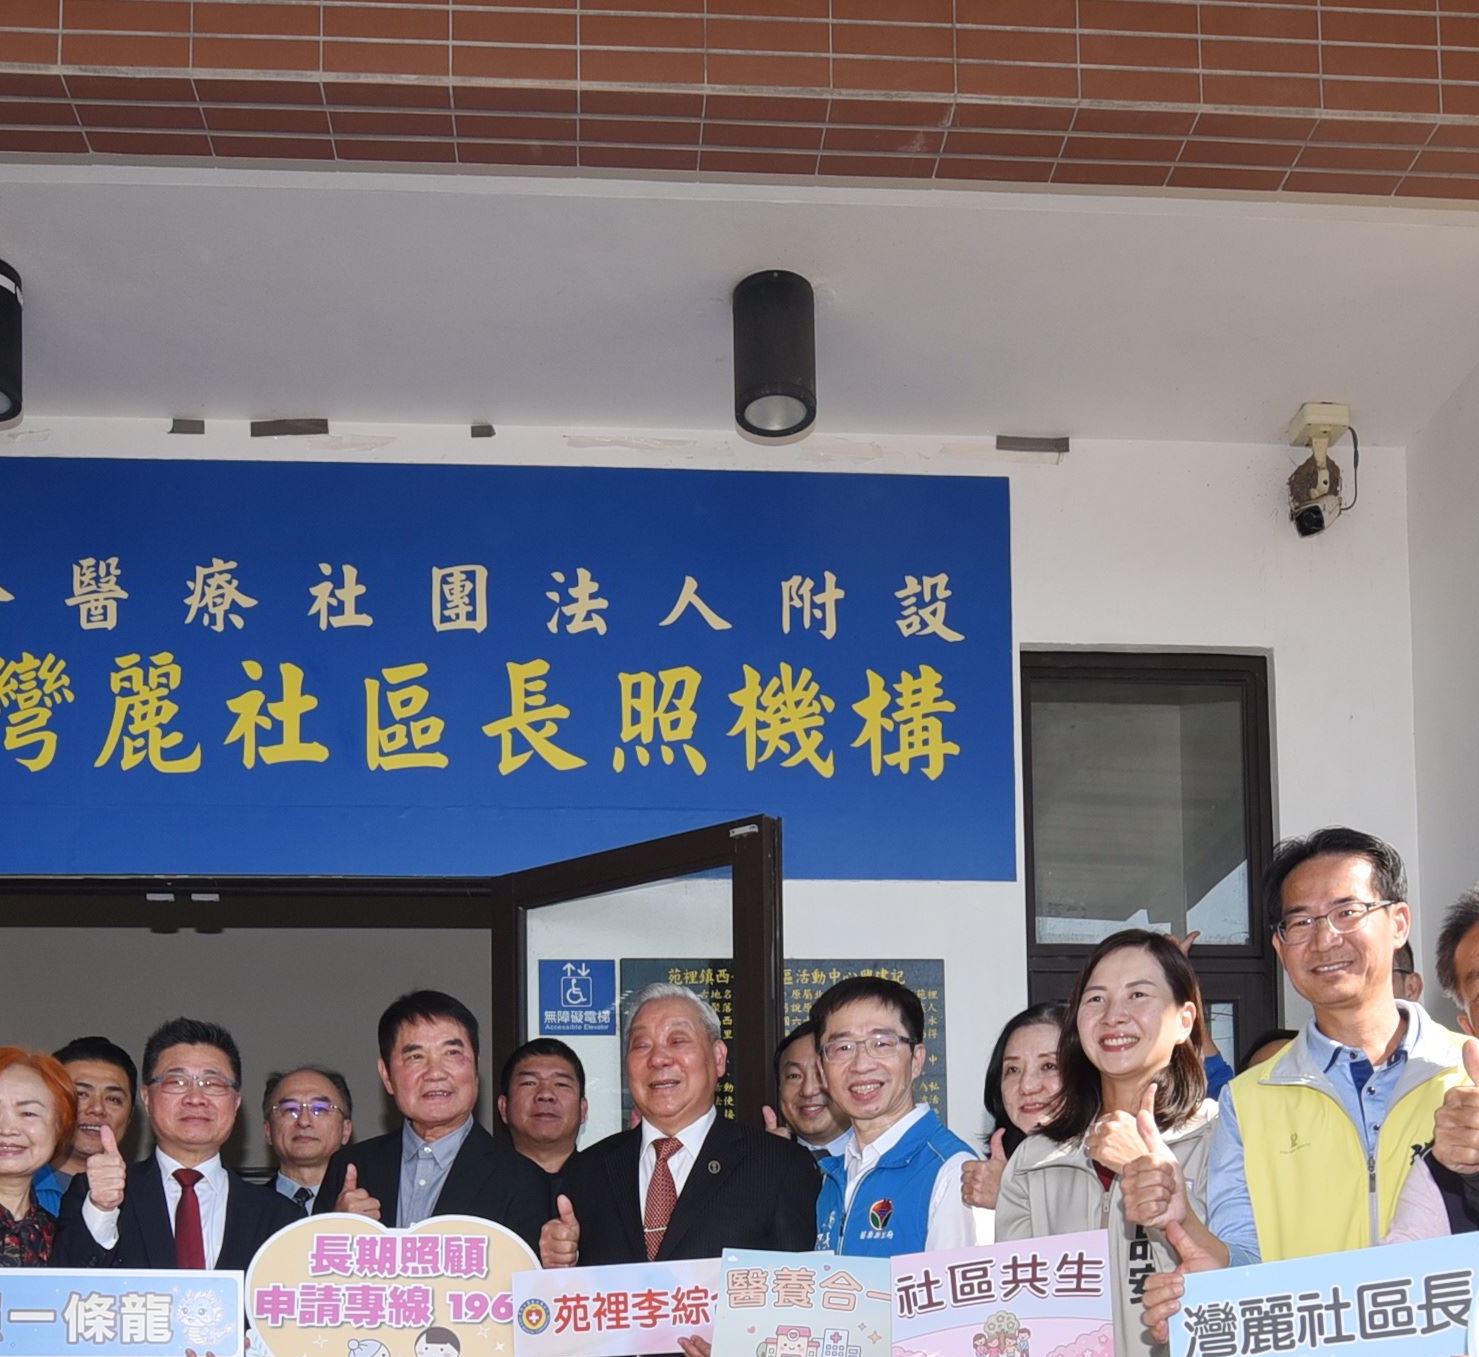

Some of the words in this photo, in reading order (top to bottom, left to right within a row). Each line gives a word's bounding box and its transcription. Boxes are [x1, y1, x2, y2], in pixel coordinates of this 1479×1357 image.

[668, 967, 734, 986] 苑裡鎮西
[544, 1010, 611, 1025] 無障礙電梯
[308, 1233, 488, 1278] 長期照顧
[255, 1284, 435, 1328] 申請專線
[896, 1251, 1105, 1319] 社區共生
[553, 1285, 719, 1335] 苑裡李綜
